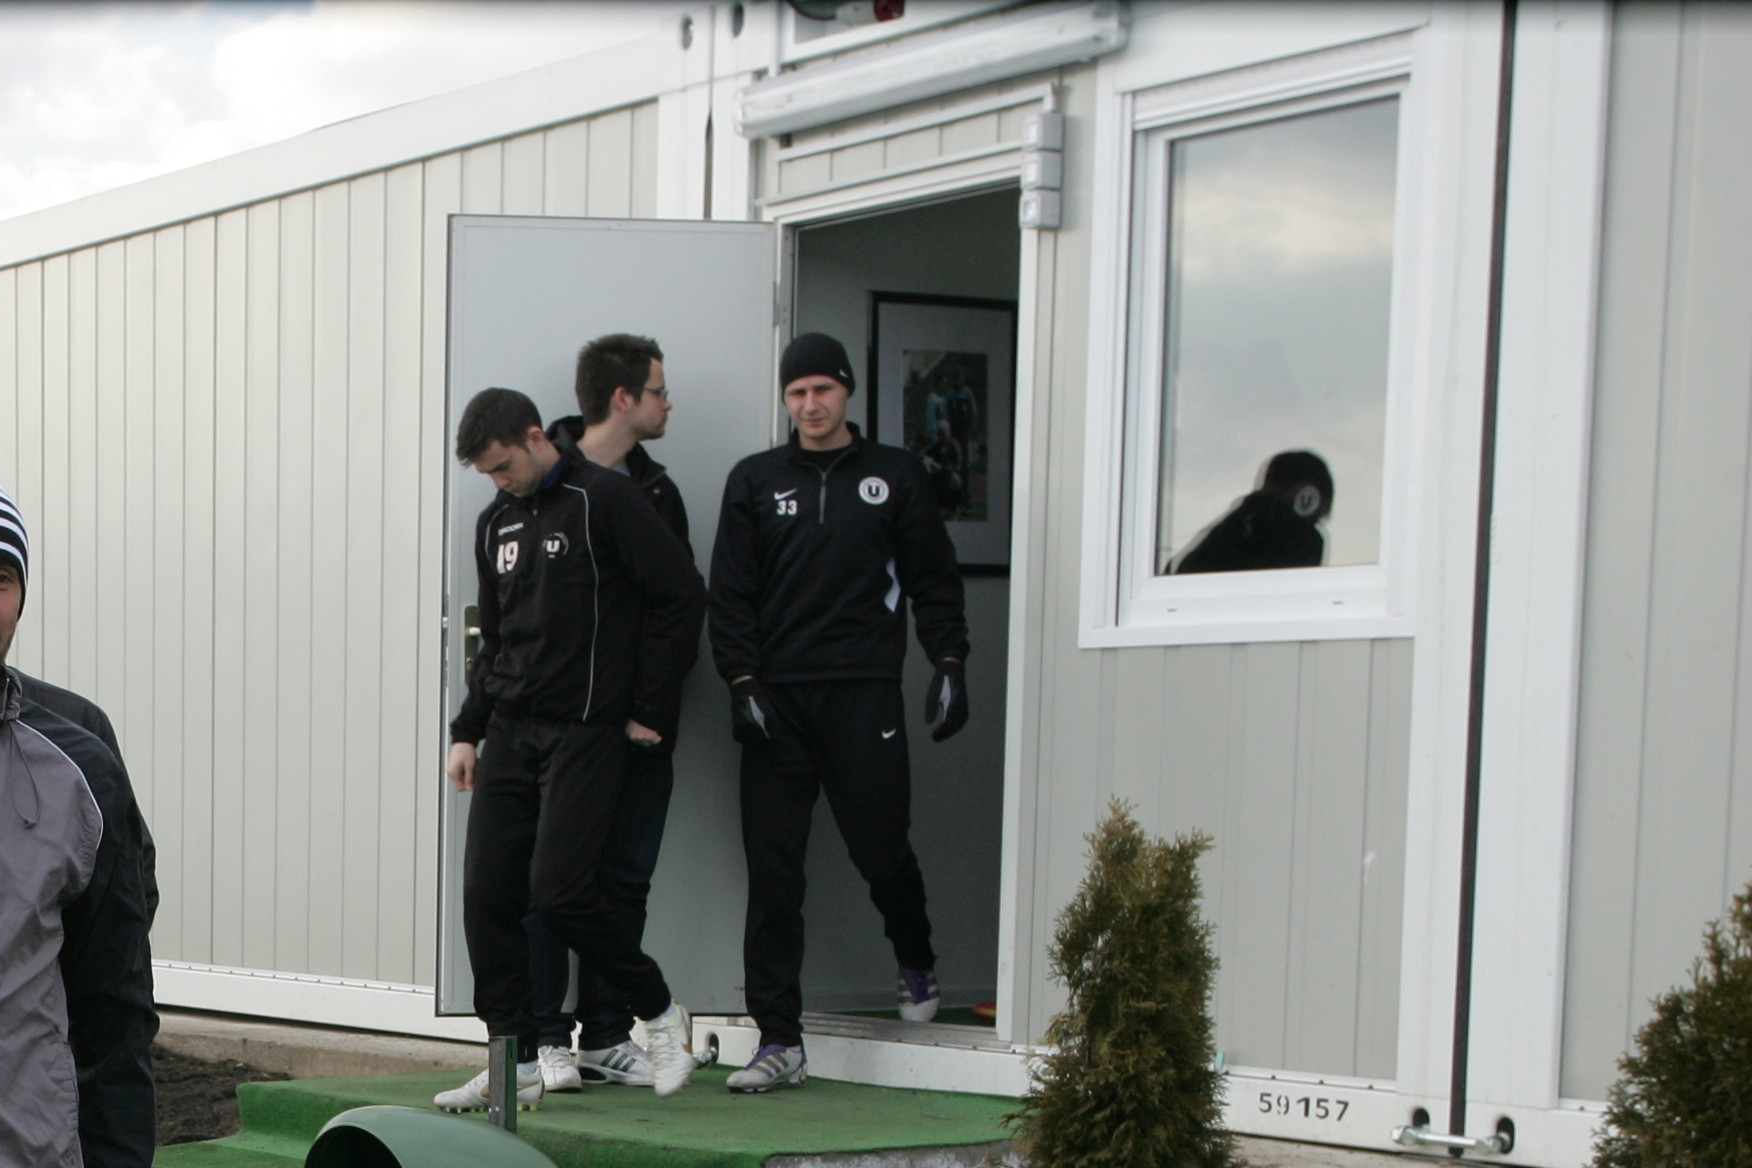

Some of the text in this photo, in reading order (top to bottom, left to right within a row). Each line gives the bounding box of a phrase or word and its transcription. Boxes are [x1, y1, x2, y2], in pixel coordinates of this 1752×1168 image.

[777, 500, 797, 515] 33
[496, 540, 519, 574] 19
[546, 540, 560, 553] U
[1258, 1092, 1349, 1121] 59157
